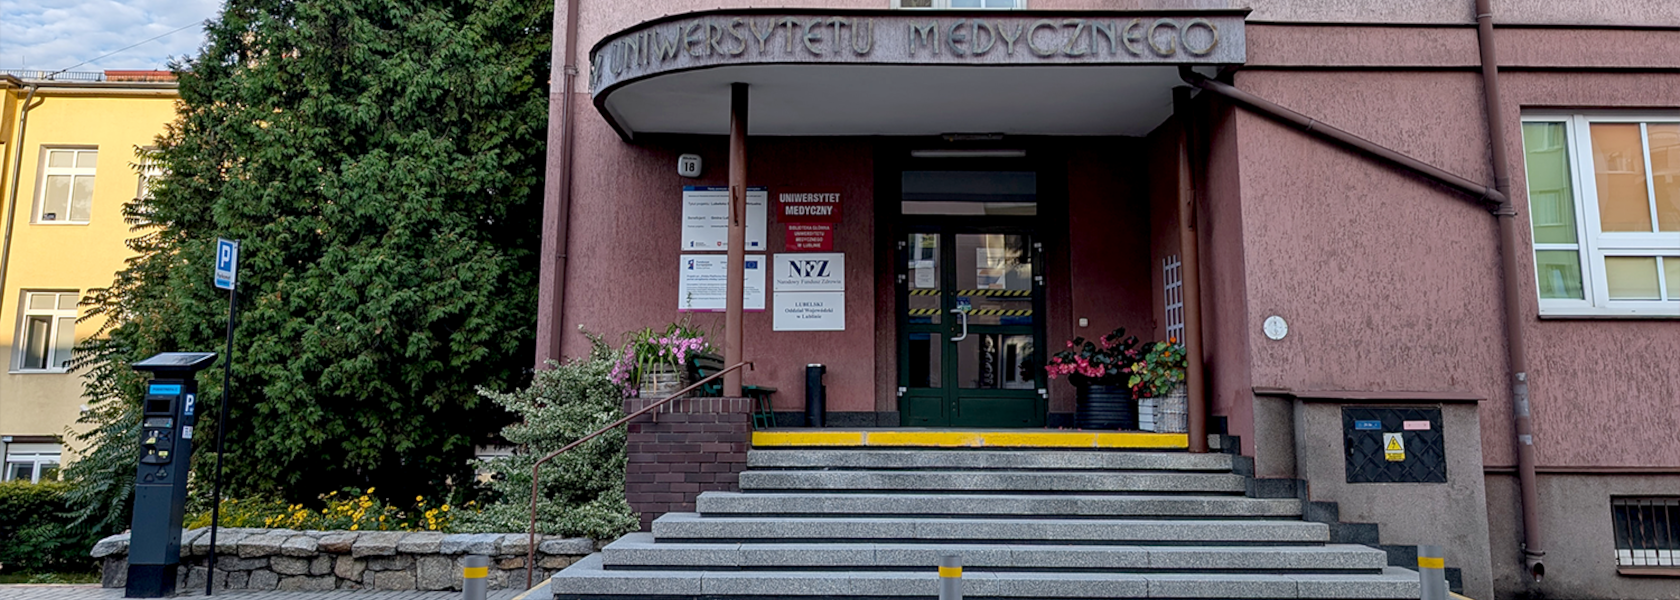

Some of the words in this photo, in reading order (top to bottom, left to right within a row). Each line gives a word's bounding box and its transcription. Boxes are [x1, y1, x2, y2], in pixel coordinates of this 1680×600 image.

[610, 16, 874, 76] UNIWERSYTETU
[908, 17, 1218, 57] MEDYCZNEGO
[684, 162, 695, 172] 18
[779, 193, 840, 203] UNIWERSYTET
[785, 205, 833, 216] MEDYCZNY
[220, 244, 231, 268] P
[788, 260, 831, 278] NFZ
[185, 394, 195, 412] P
